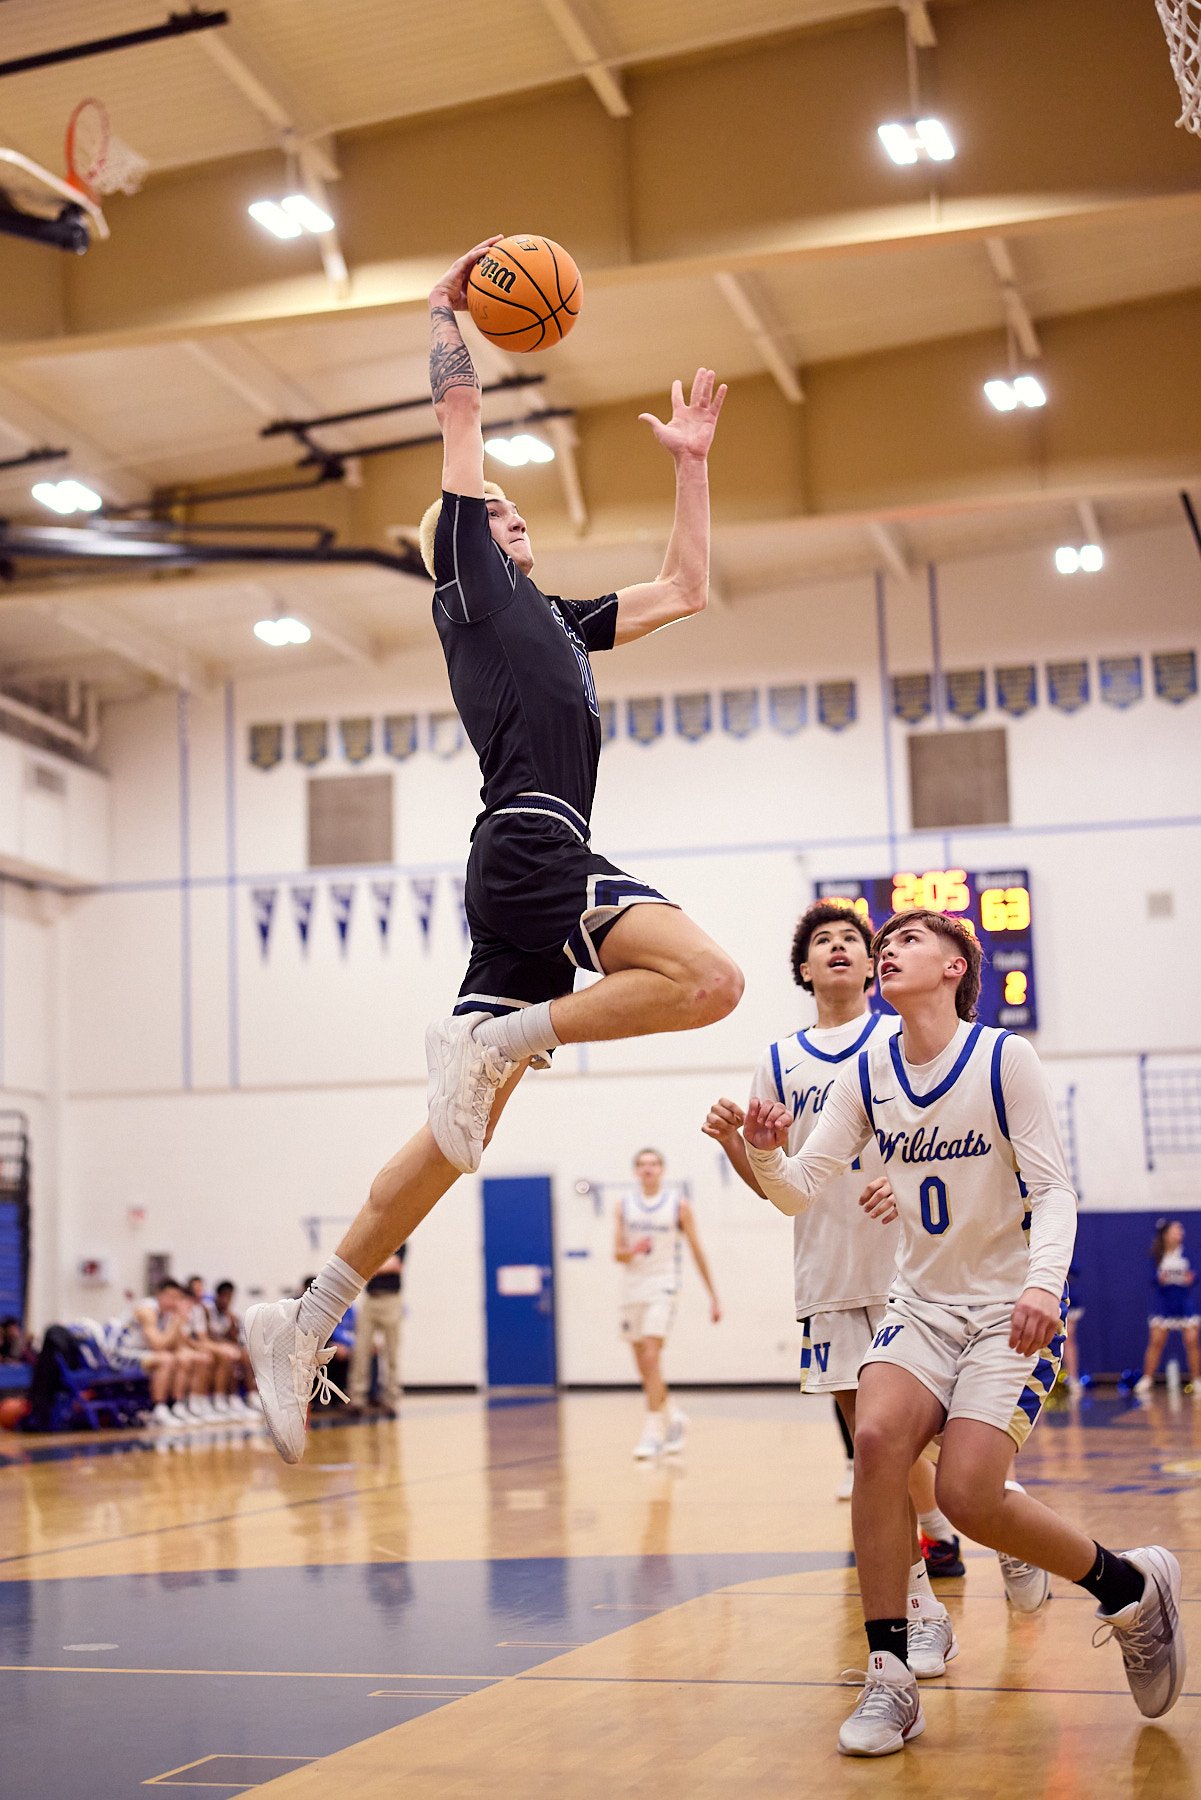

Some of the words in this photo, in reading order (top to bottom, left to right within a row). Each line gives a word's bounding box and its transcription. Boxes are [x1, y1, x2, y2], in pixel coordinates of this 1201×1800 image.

[892, 869, 970, 914] 2:05
[875, 1126, 992, 1165] Wildcats
[919, 1175, 952, 1237] 0
[872, 1324, 905, 1350] W
